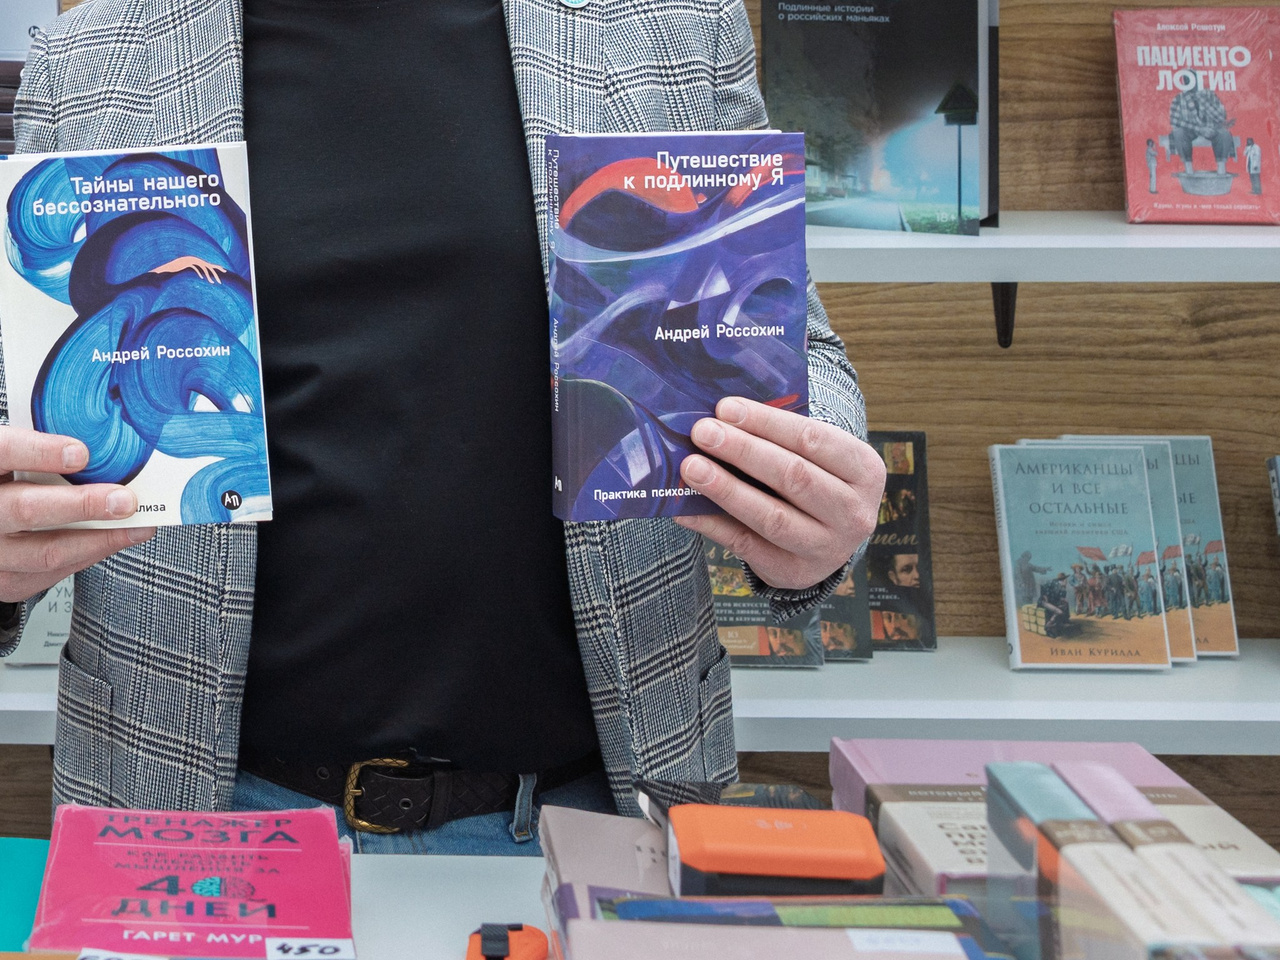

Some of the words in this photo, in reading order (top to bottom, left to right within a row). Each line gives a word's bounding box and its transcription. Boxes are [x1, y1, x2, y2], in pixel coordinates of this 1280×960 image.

[778, 2, 831, 12] Подлинные
[834, 5, 874, 13] истории
[788, 13, 842, 22] российских
[846, 14, 890, 22] маньяках
[1136, 45, 1252, 69] ПАЦИЕНТО
[1156, 70, 1236, 91] ЛОГИЯ
[656, 151, 783, 173] Путешествие
[70, 176, 134, 195] Тайны
[144, 174, 220, 191] нашего
[624, 175, 635, 190] к
[644, 171, 762, 191] подлинному
[771, 168, 784, 185] Я
[552, 149, 560, 230] Путешествие
[32, 193, 221, 216] бессознательного
[935, 211, 956, 223] 18+
[654, 324, 710, 344] Андрей
[716, 323, 785, 339] Россохин
[92, 346, 150, 365] Андрей
[157, 345, 231, 359] Россохин
[1015, 462, 1133, 476] АМЕРИКАНЦЫ
[594, 489, 647, 503] Практика
[1052, 483, 1064, 494] И
[1072, 483, 1102, 495] ВСЕ
[1029, 502, 1129, 514] ОСТАЛЬНЫЕ
[104, 814, 292, 827] ТРЕНАЖЕР
[98, 825, 300, 844] МОЗГА
[123, 930, 196, 943] ГАРЕТ
[207, 931, 262, 944] МУР
